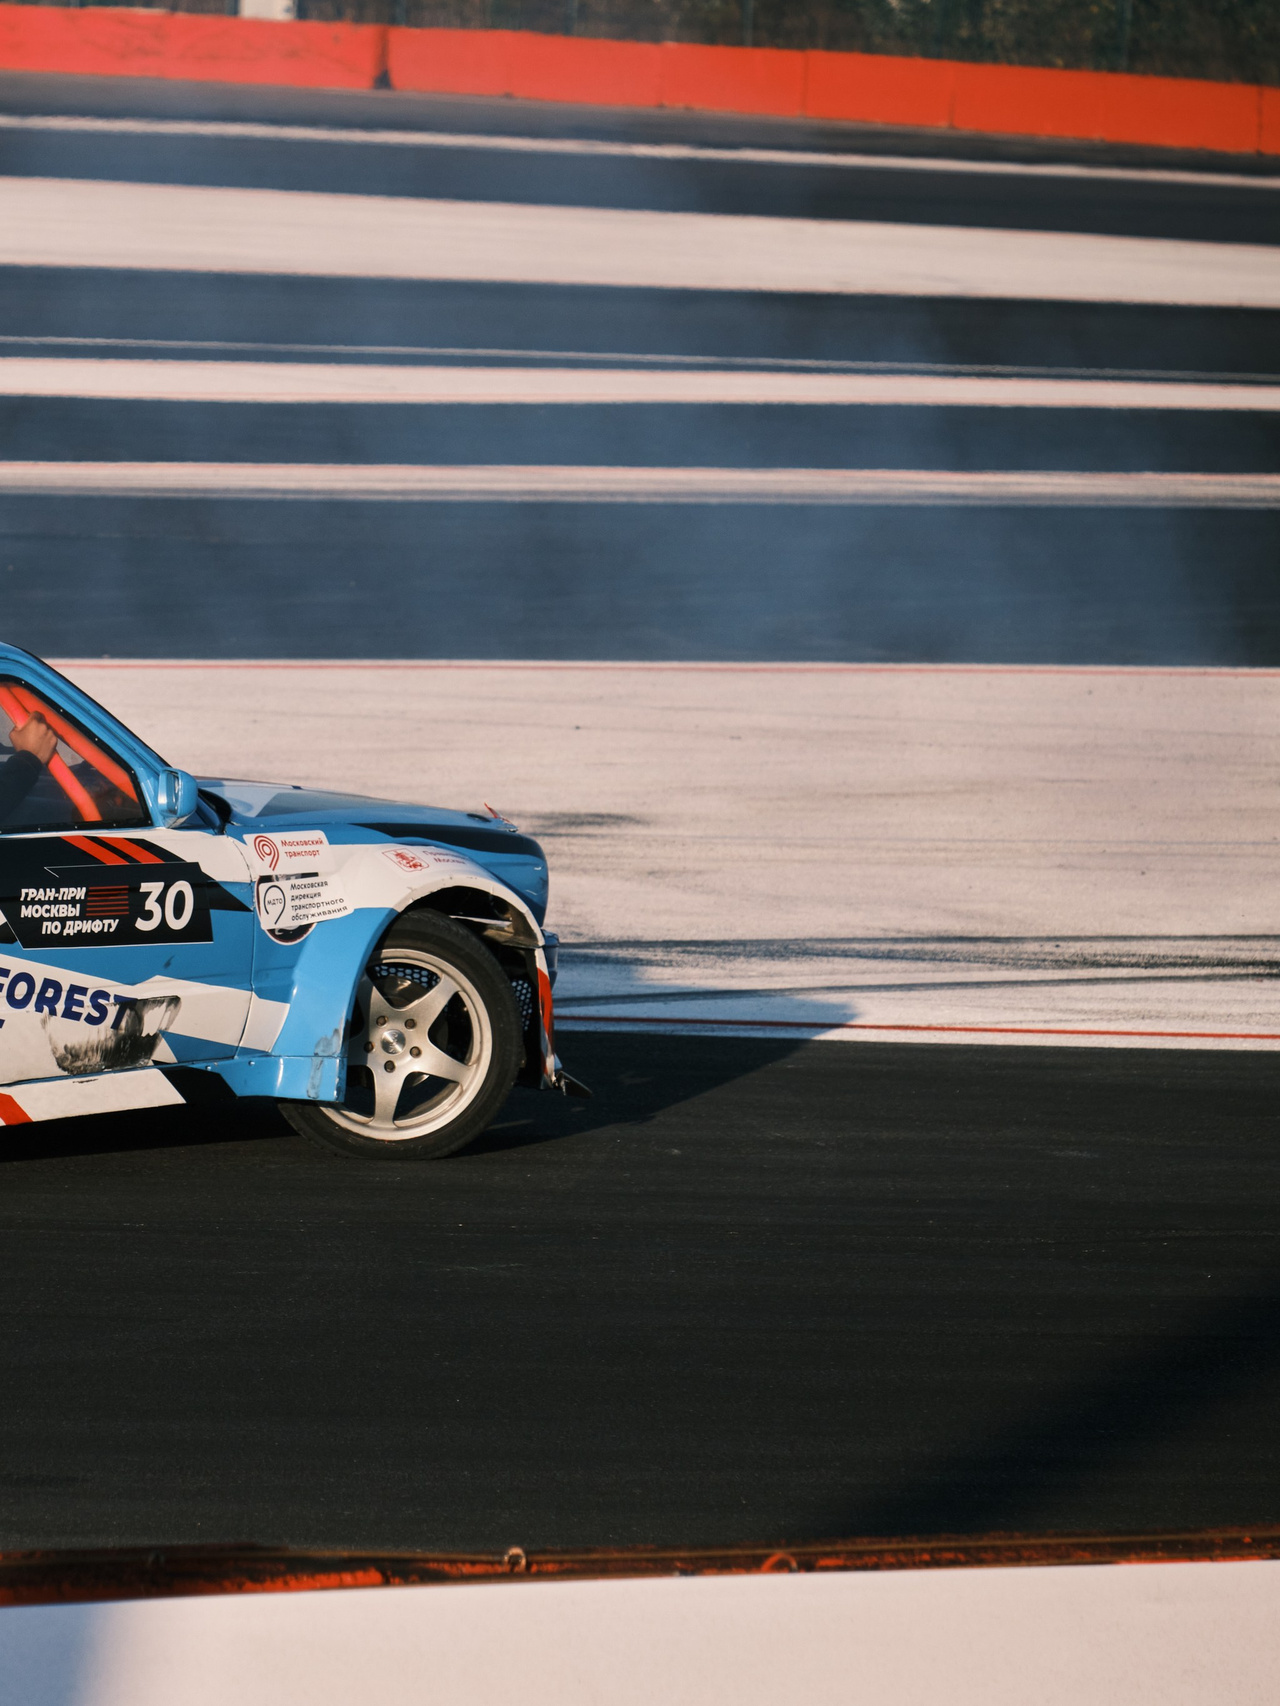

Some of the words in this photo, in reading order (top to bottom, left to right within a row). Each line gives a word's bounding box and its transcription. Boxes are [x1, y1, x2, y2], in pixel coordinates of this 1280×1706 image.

[281, 838, 324, 847] Московский
[285, 850, 320, 859] транспорт
[290, 881, 328, 891] Московская
[291, 892, 321, 902] дирекция
[20, 887, 87, 901] ГРАН-ПРИ
[134, 880, 195, 932] 30
[21, 904, 80, 918] МОСКВЫ
[291, 898, 345, 912] транспортного
[291, 906, 348, 921] обслуживания
[41, 921, 62, 935] ПО
[63, 919, 119, 936] ДРИФТУ
